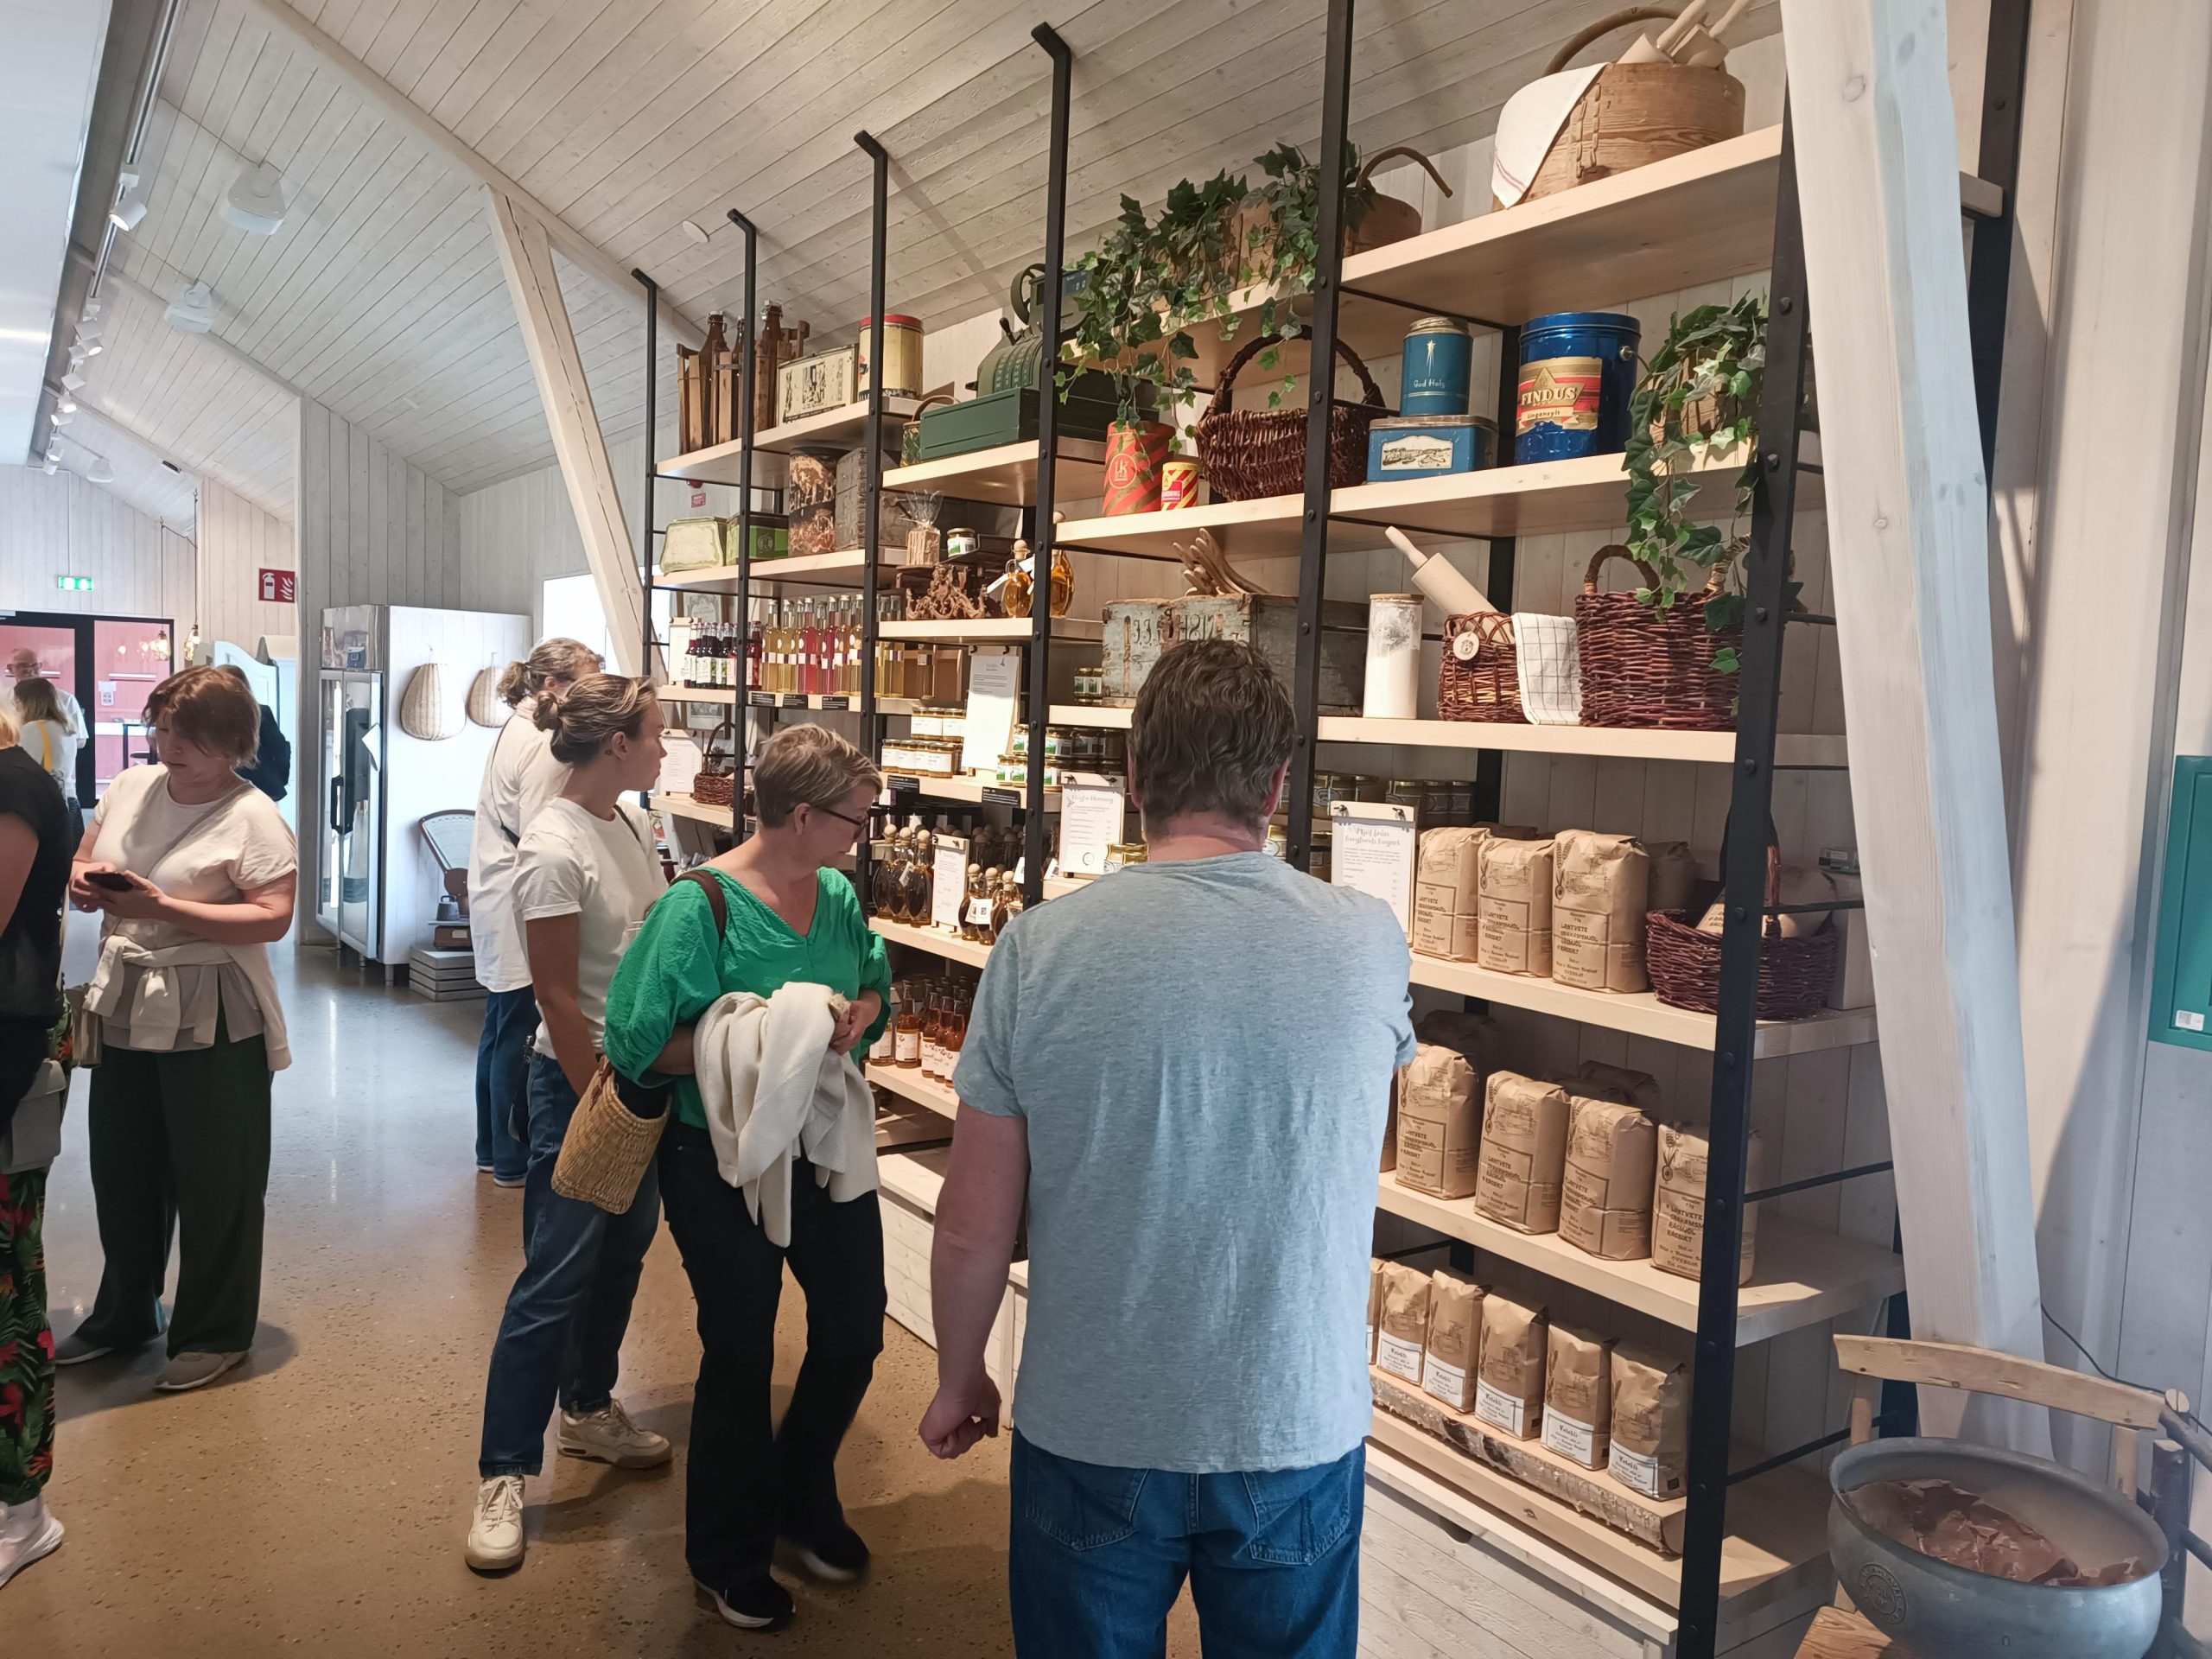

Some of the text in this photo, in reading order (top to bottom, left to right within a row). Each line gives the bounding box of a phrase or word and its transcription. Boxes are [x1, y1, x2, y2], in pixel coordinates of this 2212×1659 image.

[1413, 378, 1427, 388] God
[1521, 386, 1578, 406] FINDUS
[1670, 1205, 1703, 1221] LANTVETE
[1669, 1213, 1703, 1230] GRAHAMSM
